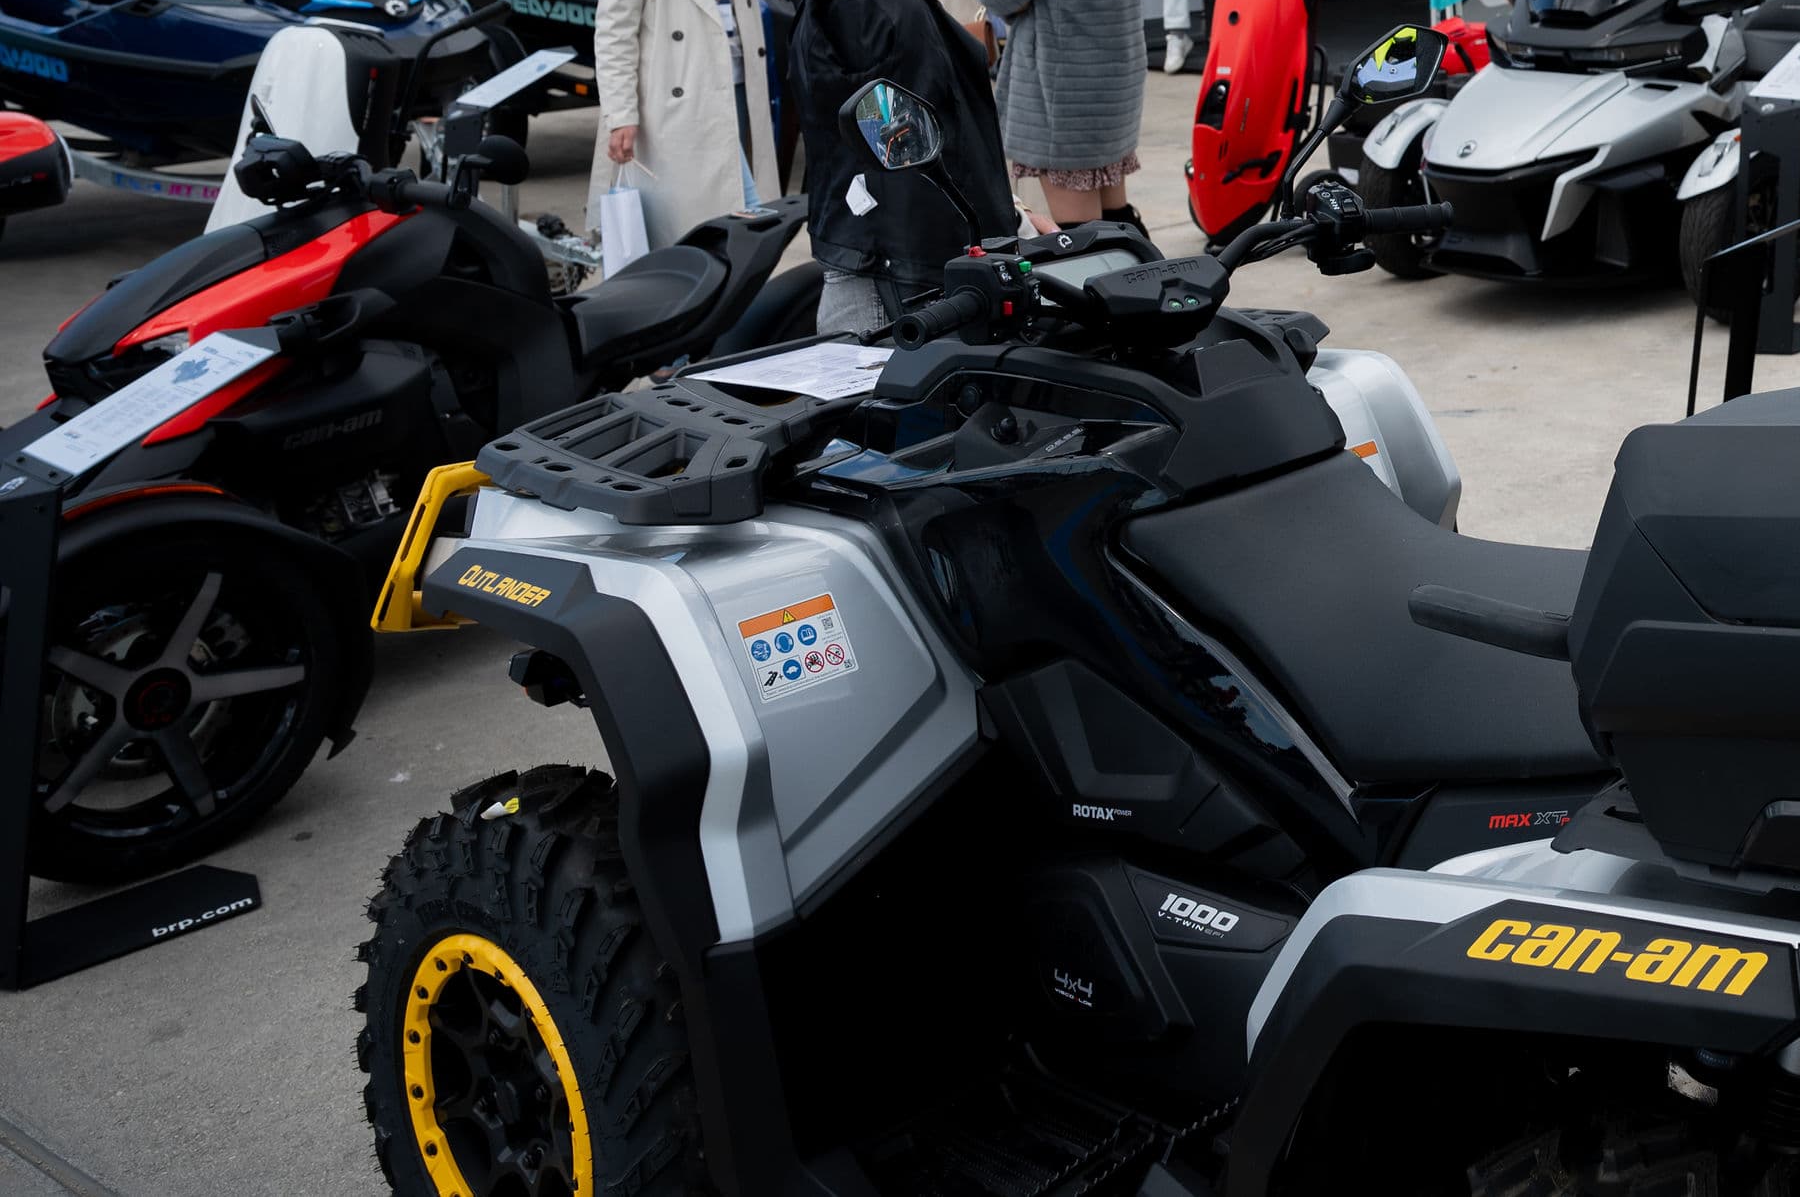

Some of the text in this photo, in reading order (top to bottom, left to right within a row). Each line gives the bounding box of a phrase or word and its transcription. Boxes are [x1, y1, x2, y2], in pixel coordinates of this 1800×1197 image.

[458, 565, 552, 608] OUTLANDER
[1072, 803, 1132, 821] ROTAX POWER
[1488, 812, 1532, 829] MAX
[152, 897, 253, 938] brp.com
[1160, 893, 1240, 932] 1000
[1467, 919, 1769, 996] can-am
[1054, 967, 1094, 998] 4x4
